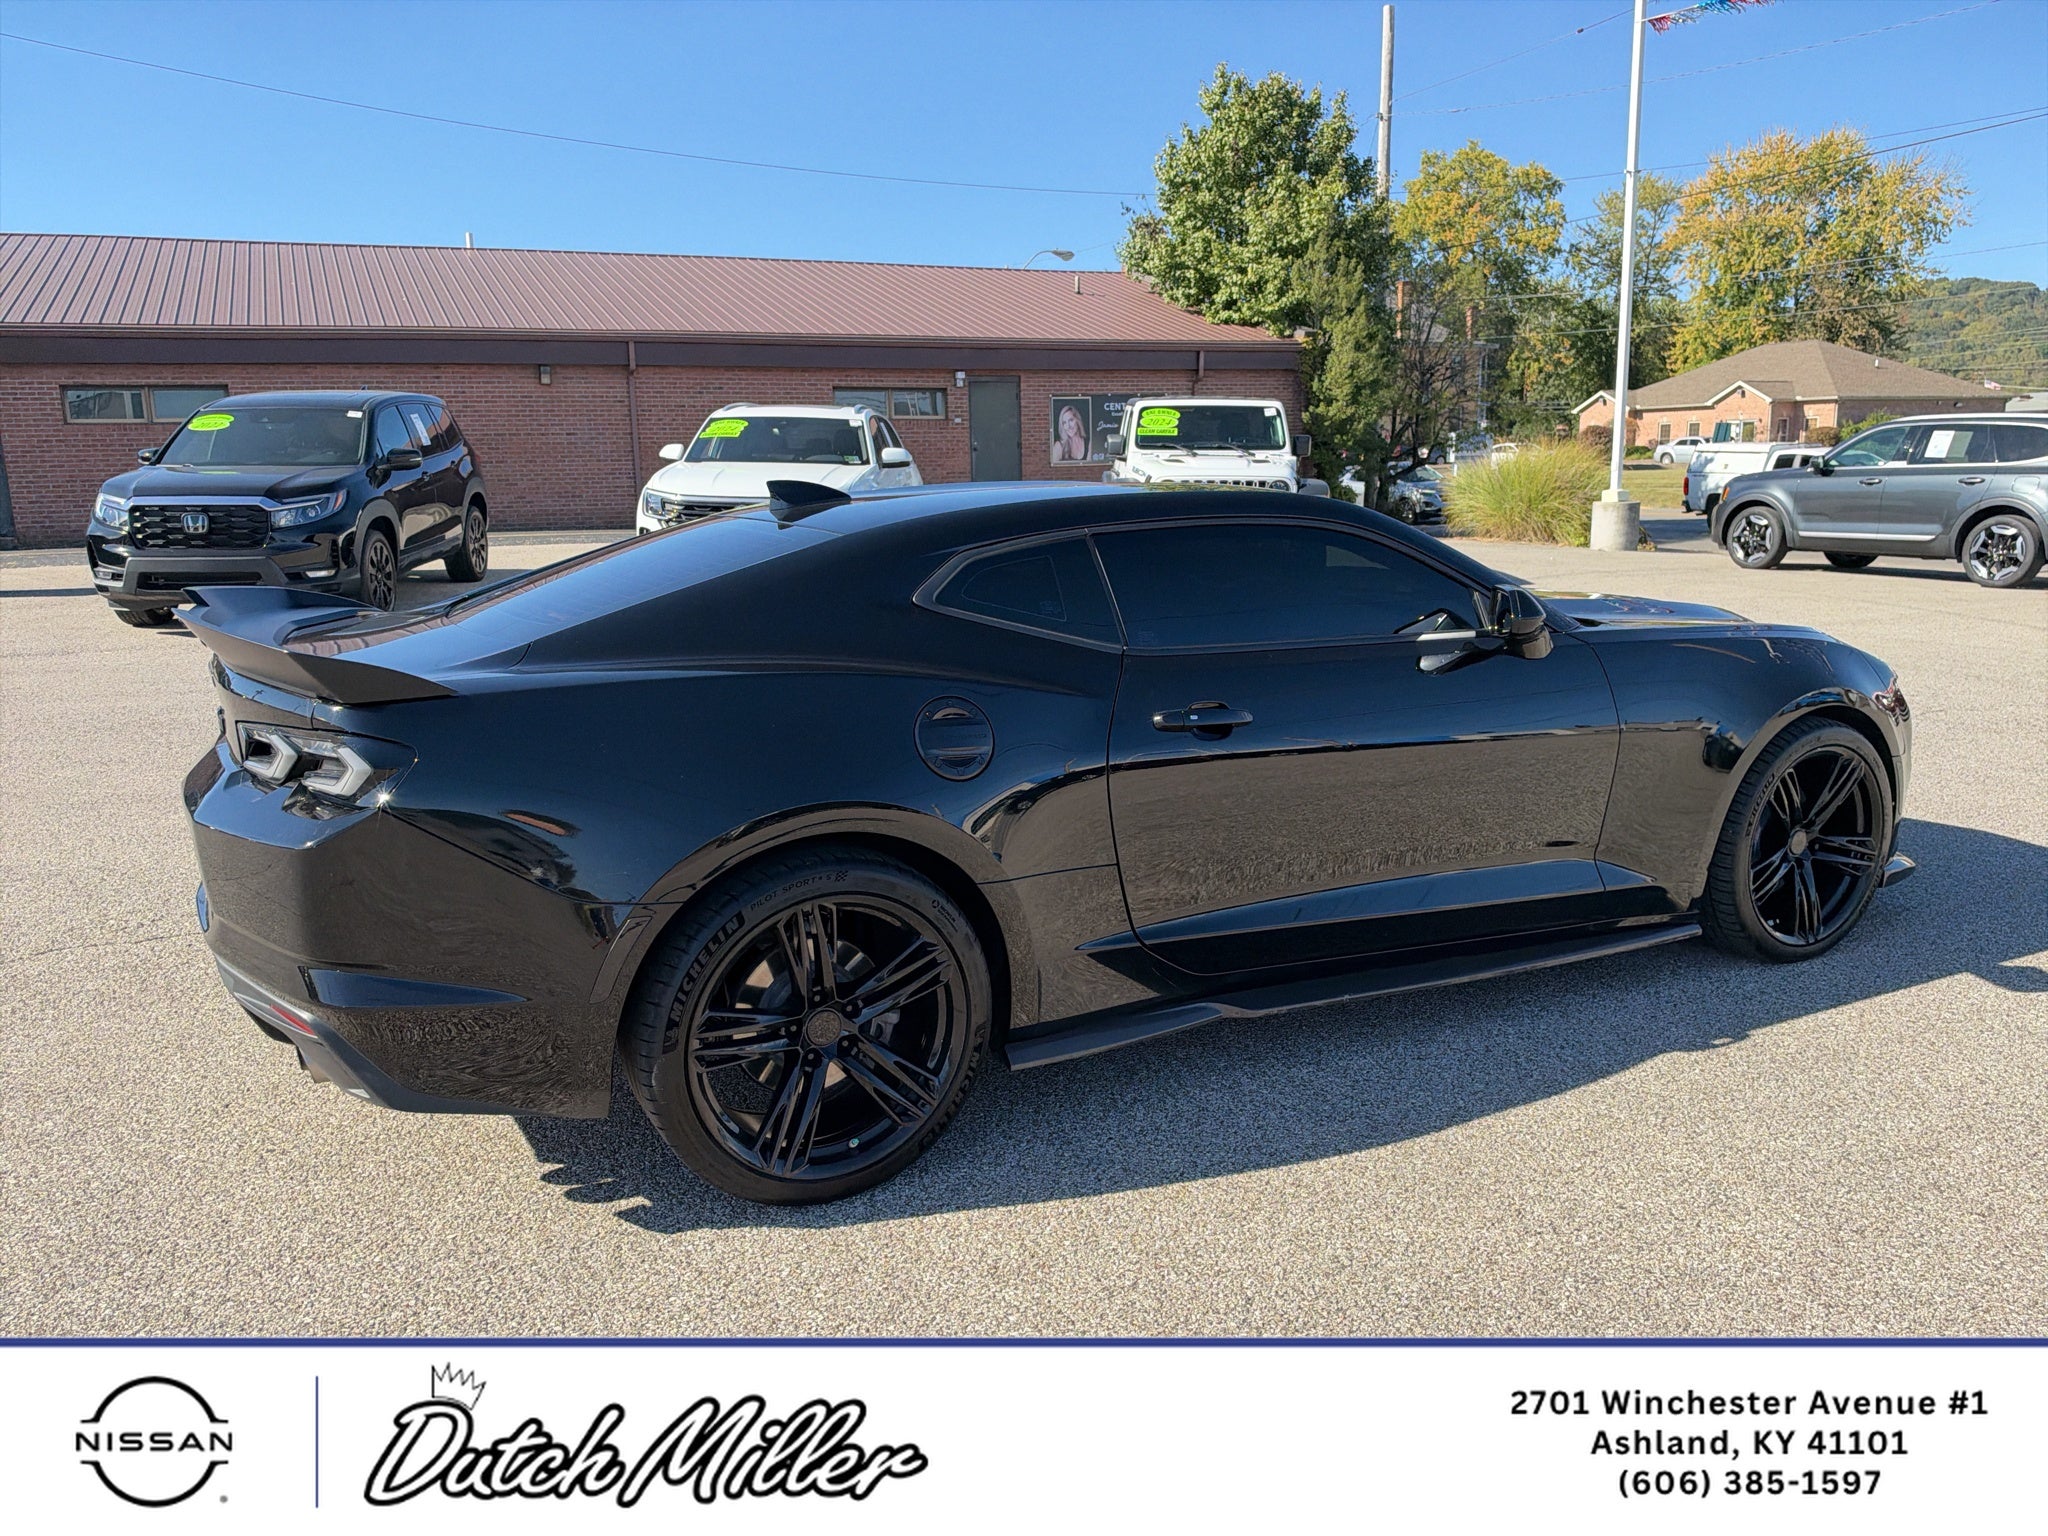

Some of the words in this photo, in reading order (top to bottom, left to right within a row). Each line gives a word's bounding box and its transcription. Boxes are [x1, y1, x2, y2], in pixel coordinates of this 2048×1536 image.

[750, 890, 778, 911] PILOT
[782, 876, 817, 892] SPORT
[669, 915, 741, 1018] MICHELIN
